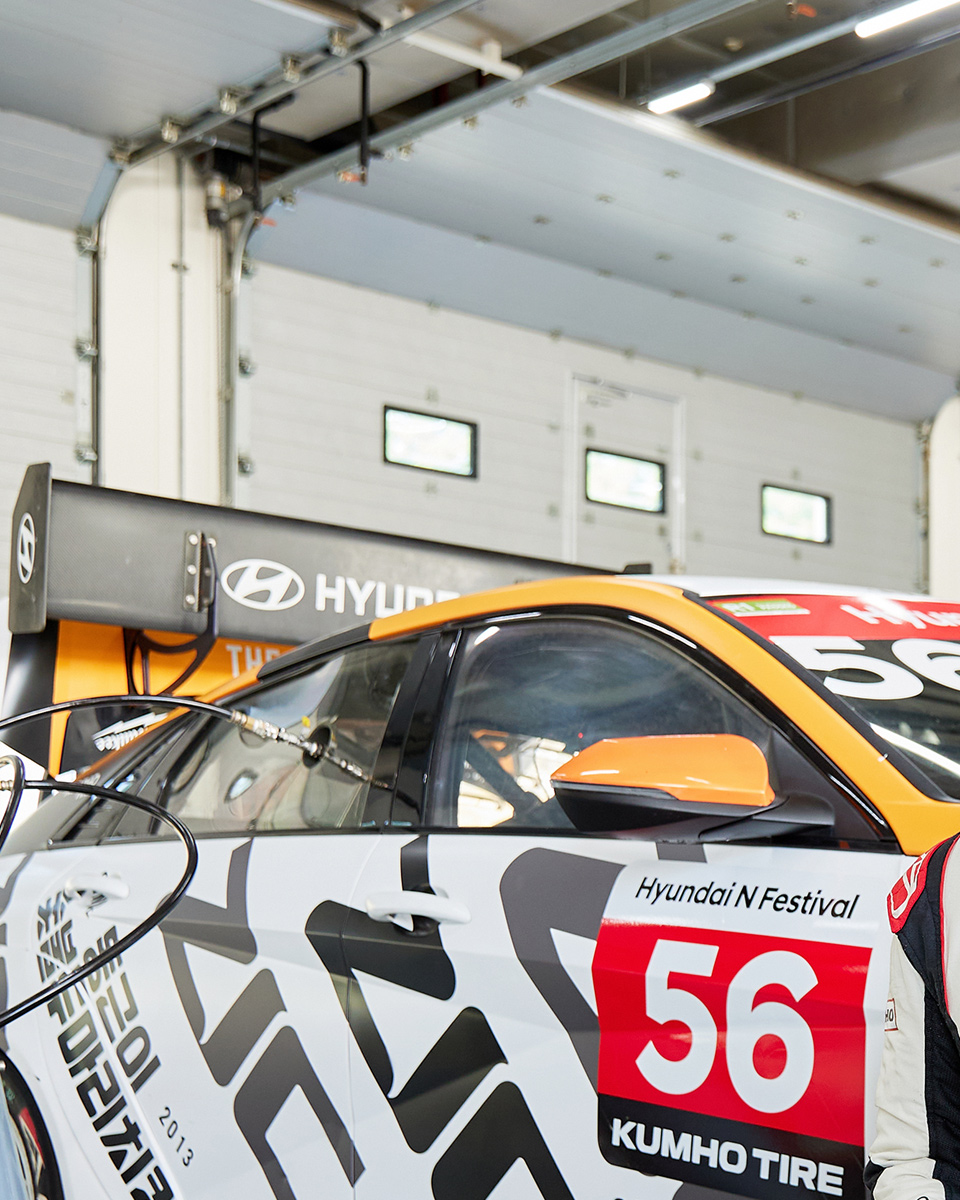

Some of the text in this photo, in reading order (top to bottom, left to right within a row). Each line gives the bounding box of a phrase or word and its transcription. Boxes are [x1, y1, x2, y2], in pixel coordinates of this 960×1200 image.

[315, 573, 460, 618] HYUN
[635, 877, 859, 919] Hyundai N Festival
[635, 938, 818, 1113] 56
[158, 1107, 194, 1167] 2013
[611, 1118, 844, 1197] KUMHO TIRE
